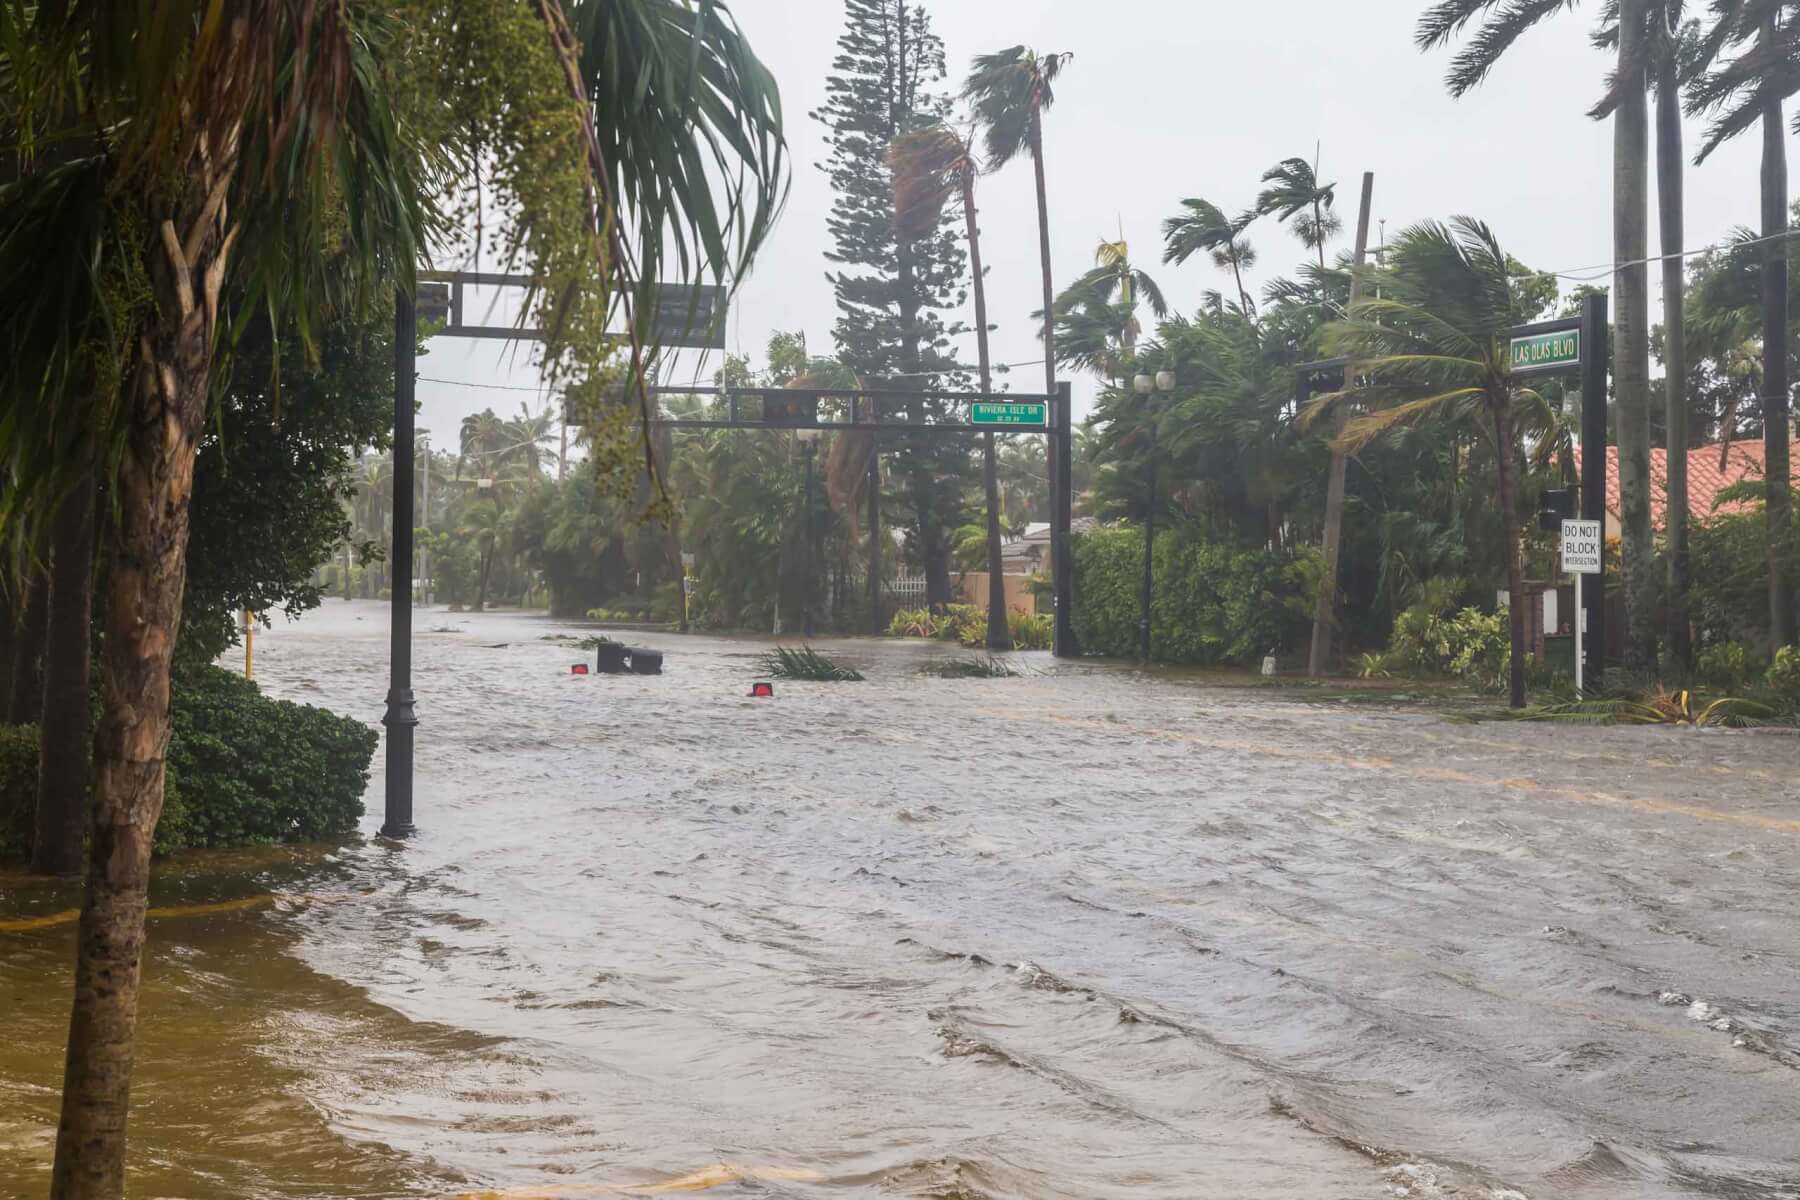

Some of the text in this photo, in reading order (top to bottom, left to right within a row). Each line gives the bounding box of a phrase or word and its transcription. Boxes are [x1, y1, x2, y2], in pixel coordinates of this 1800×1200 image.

[1514, 338, 1574, 363] LAS OLAS BLVD
[979, 405, 1038, 415] RIVIERA ISLE DR
[1565, 526, 1598, 537] DO NOT
[1566, 542, 1596, 554] BLOCK
